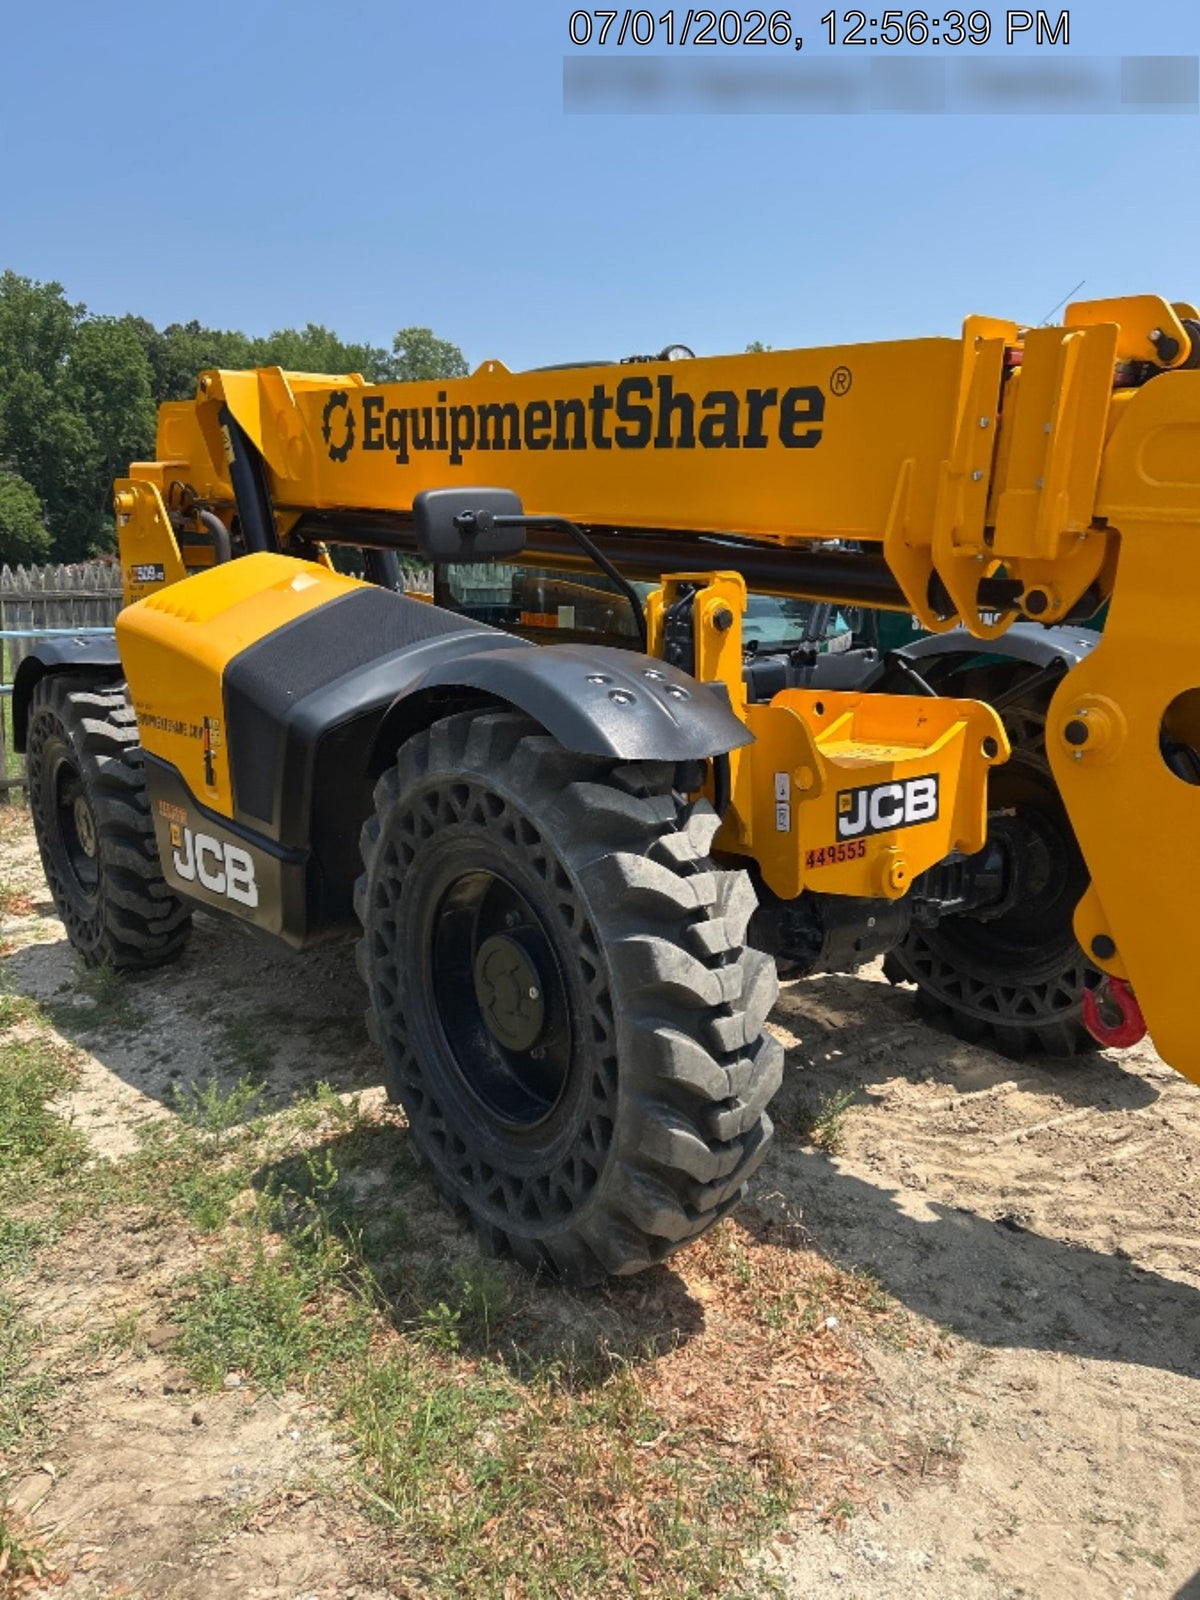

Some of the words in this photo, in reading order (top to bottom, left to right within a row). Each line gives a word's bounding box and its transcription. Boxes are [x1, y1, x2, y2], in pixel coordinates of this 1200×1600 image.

[838, 778, 938, 836] JCB
[173, 827, 259, 908] JCB
[805, 839, 867, 869] 449555
